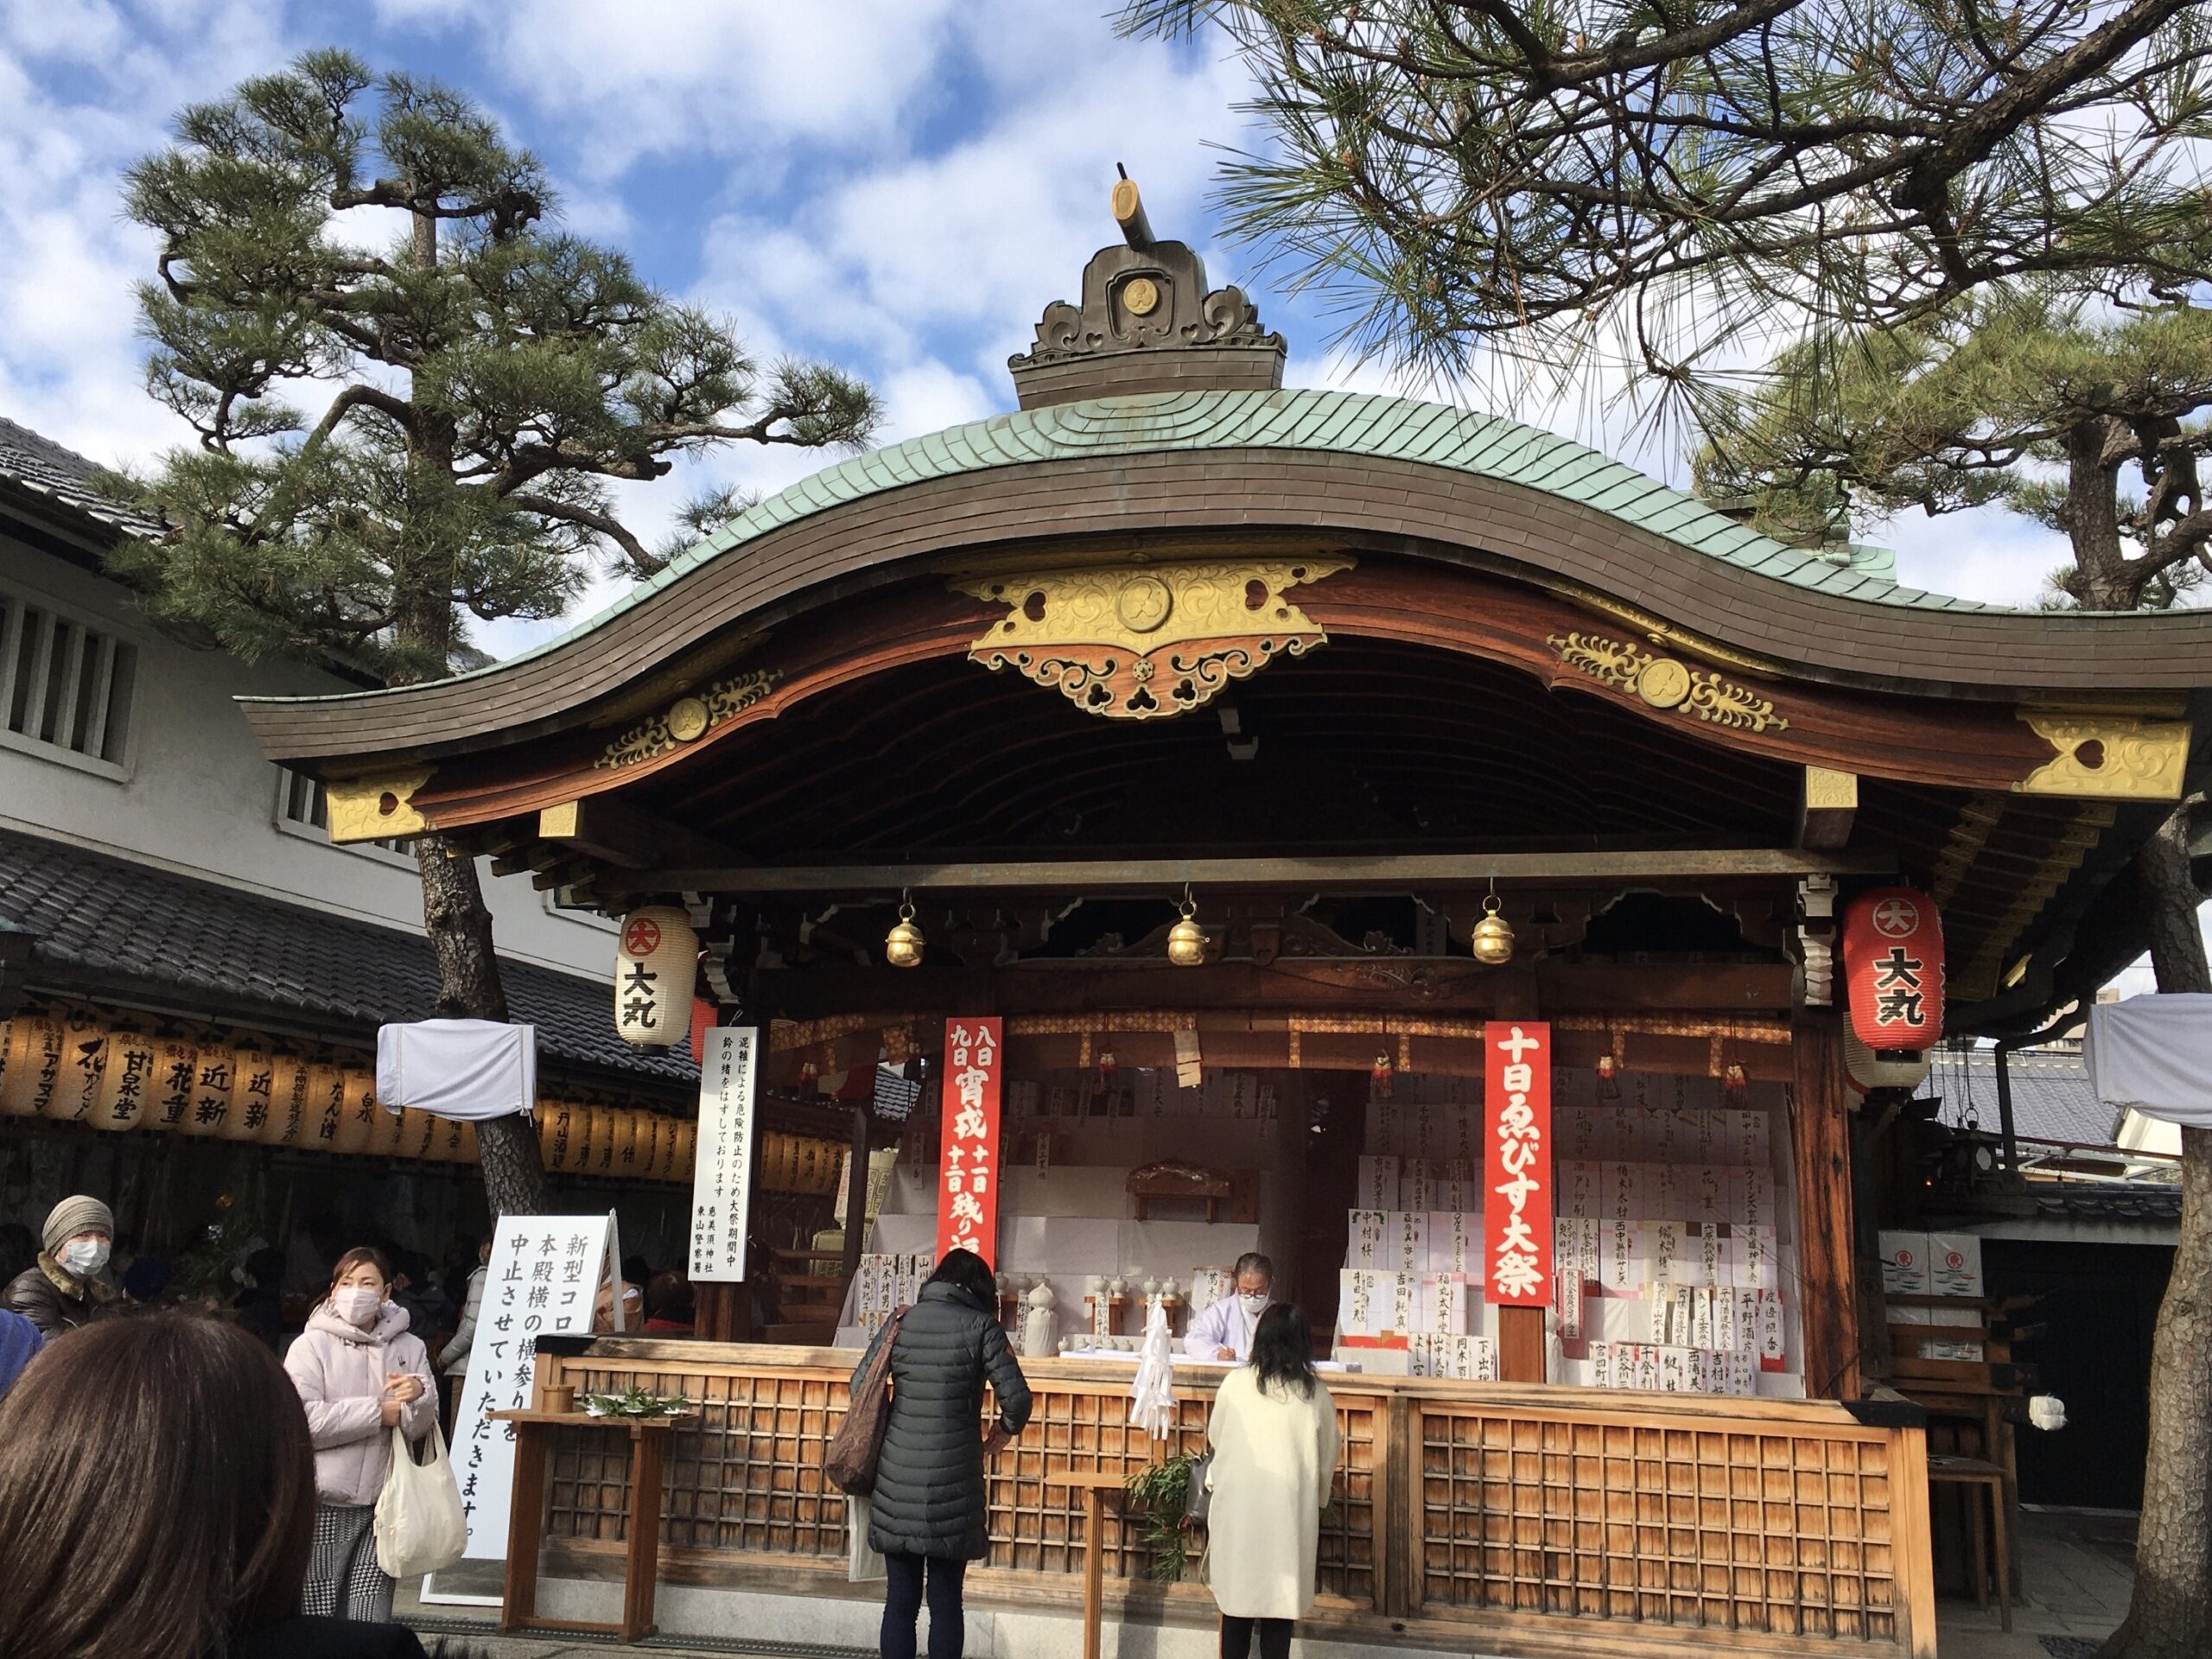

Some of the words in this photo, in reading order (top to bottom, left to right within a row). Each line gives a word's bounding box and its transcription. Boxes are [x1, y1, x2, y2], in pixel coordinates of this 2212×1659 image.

[624, 963, 658, 1028] 大丸
[1872, 947, 1926, 1027] 大丸
[950, 1025, 972, 1066] 九日
[975, 1025, 996, 1066] 八日
[112, 1050, 147, 1120] 甘泉堂
[161, 1062, 194, 1123] 花重
[194, 1064, 230, 1126] 近新
[244, 1070, 270, 1129] 近新
[715, 1037, 734, 1198] 鈴の緒をはずしております
[944, 1144, 966, 1194] 十二日
[970, 1144, 989, 1194] 十一日
[1492, 1026, 1544, 1299] 十日ゑびす大祭
[694, 1205, 705, 1273] 東山警察署
